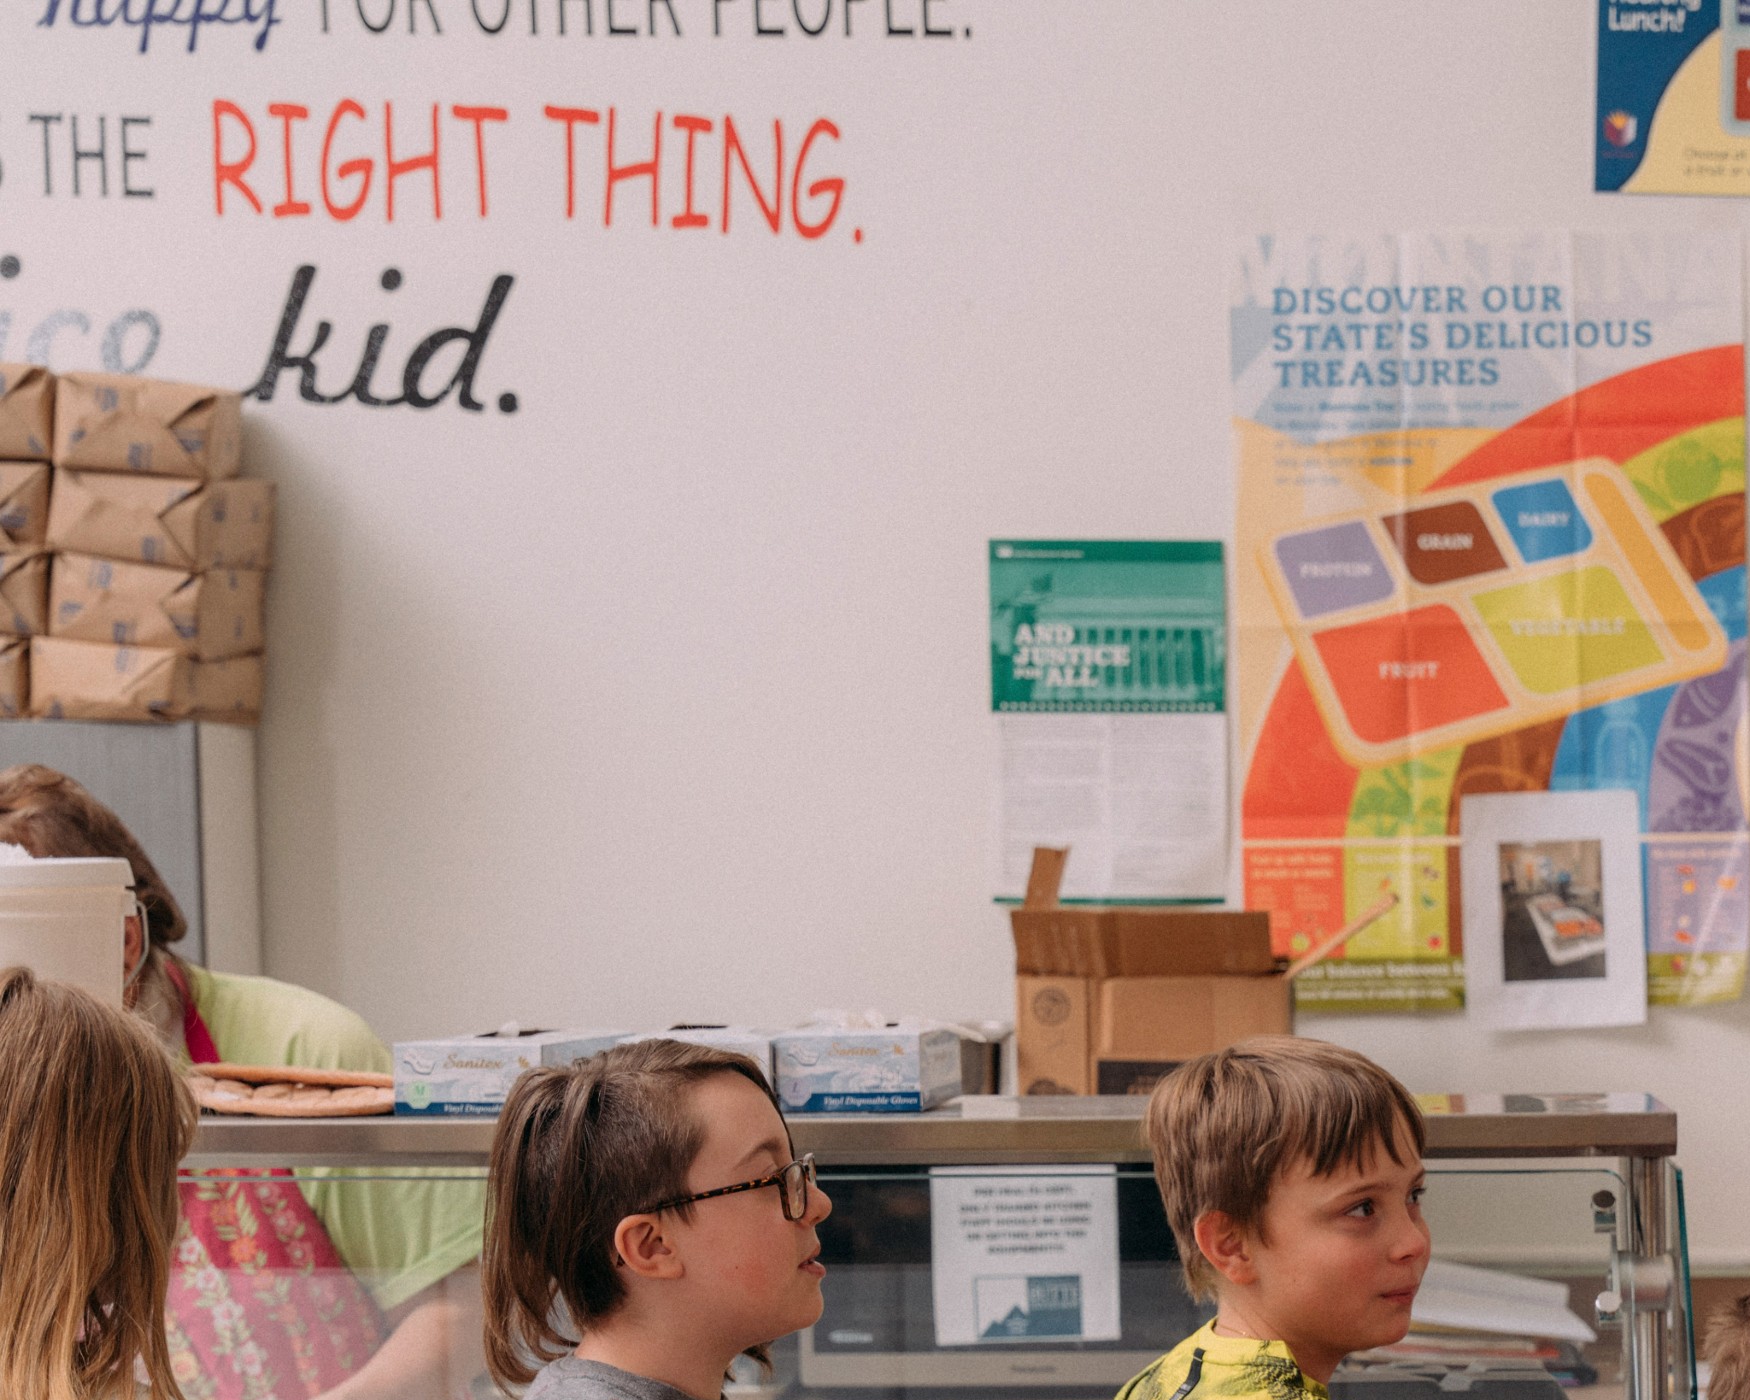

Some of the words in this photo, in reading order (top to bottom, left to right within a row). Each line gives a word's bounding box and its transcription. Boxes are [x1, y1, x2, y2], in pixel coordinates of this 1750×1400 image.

[1608, 6, 1687, 34] Lunch!
[29, 114, 155, 198] THE
[211, 98, 509, 222] RIGHT
[544, 104, 864, 244] THING.
[1271, 285, 1470, 316] DISCOVER
[1481, 284, 1564, 313] OUR
[240, 265, 520, 414] kid.
[1271, 321, 1431, 352] STATE'S
[1445, 319, 1654, 350] DELICIOUS
[1273, 358, 1501, 389] TREASURES
[1517, 510, 1571, 528] DAIRY
[1417, 532, 1474, 551] GRAIN
[1014, 622, 1076, 646] AND
[1012, 644, 1131, 667] JUSTICE
[1013, 666, 1043, 681] FOR
[1045, 666, 1100, 688] ALL
[1379, 661, 1440, 680] FRUIT
[442, 1052, 506, 1070] Sanitex
[828, 1042, 880, 1058] Sanitex
[890, 1094, 918, 1106] Gloves
